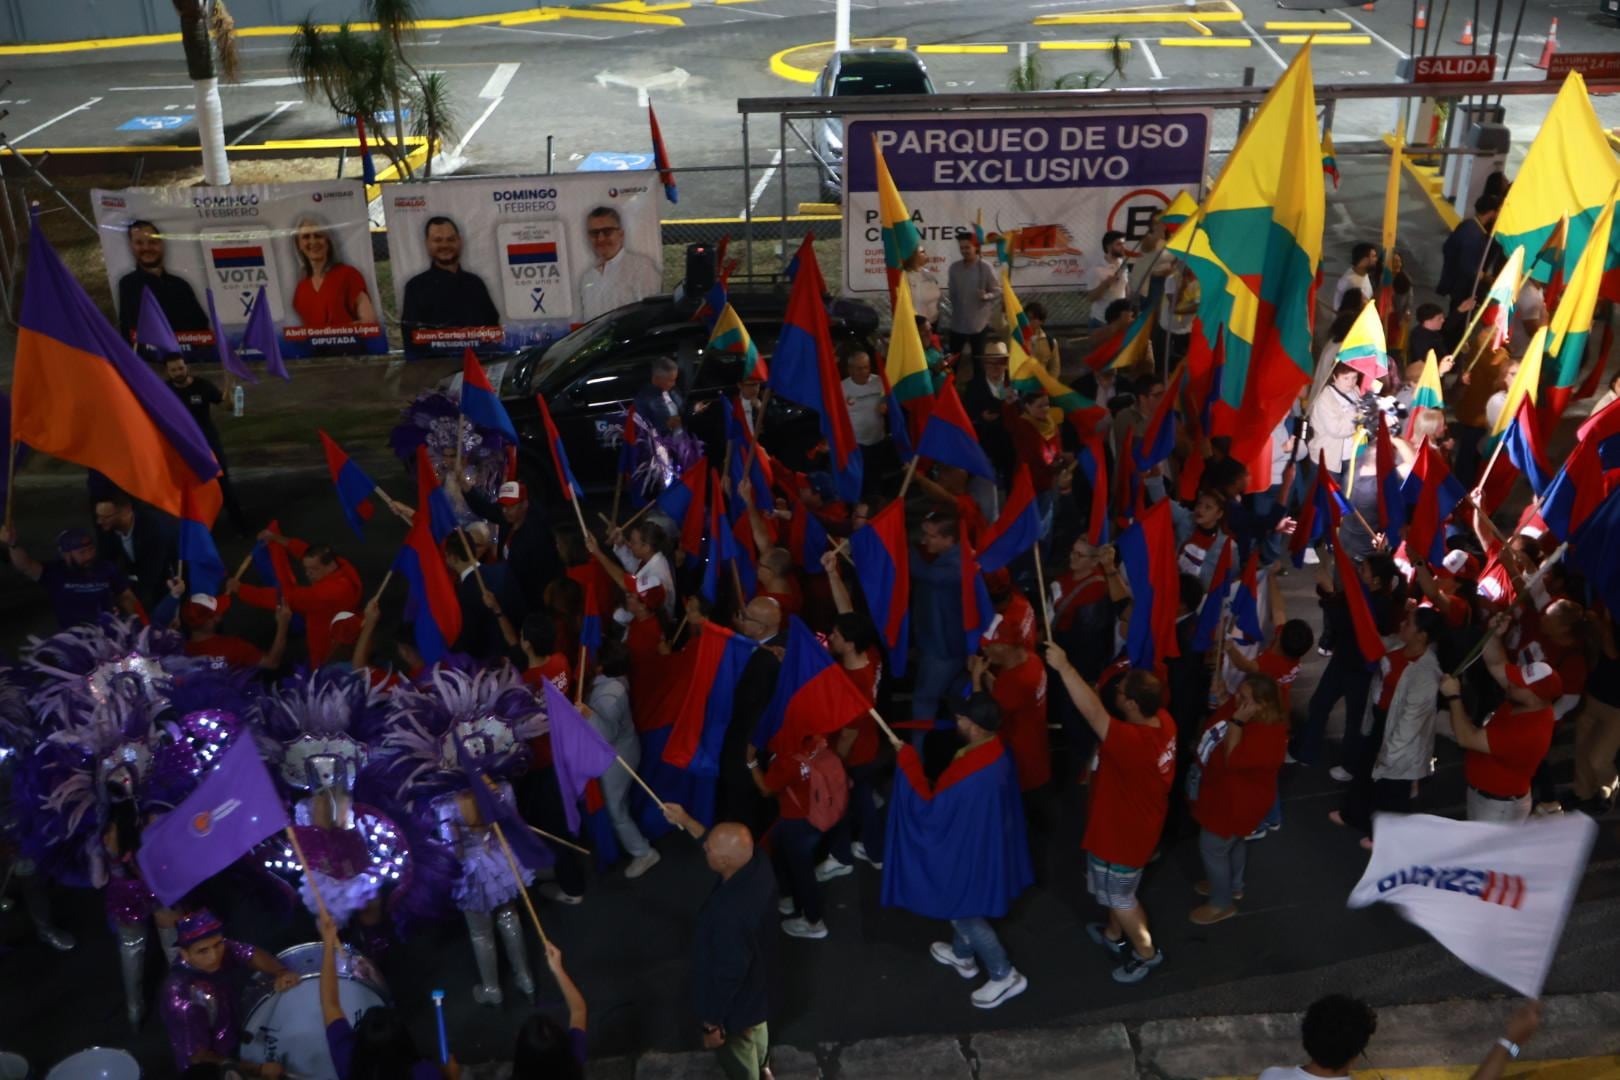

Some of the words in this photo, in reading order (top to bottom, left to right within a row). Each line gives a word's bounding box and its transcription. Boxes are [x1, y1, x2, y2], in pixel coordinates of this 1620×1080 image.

[1417, 59, 1490, 76] SALIDA
[876, 127, 1049, 154] PARQUEO
[1060, 126, 1105, 152] DE
[1117, 123, 1189, 150] USO
[933, 155, 1130, 185] EXCLUSIVO
[193, 194, 259, 208] DOMINGO
[493, 188, 557, 202] DOMINGO
[204, 207, 260, 219] FEBRERO
[504, 201, 557, 213] FEBRERO
[866, 209, 924, 224] PA
[217, 269, 268, 283] VOTA
[511, 264, 561, 279] VOTA
[285, 328, 307, 337] Abril
[415, 331, 437, 341] Juan
[438, 331, 466, 340] Carlos
[467, 328, 501, 340] Hidalgo
[311, 336, 357, 345] DIPUTADA
[431, 340, 480, 348] PRESIDENTE
